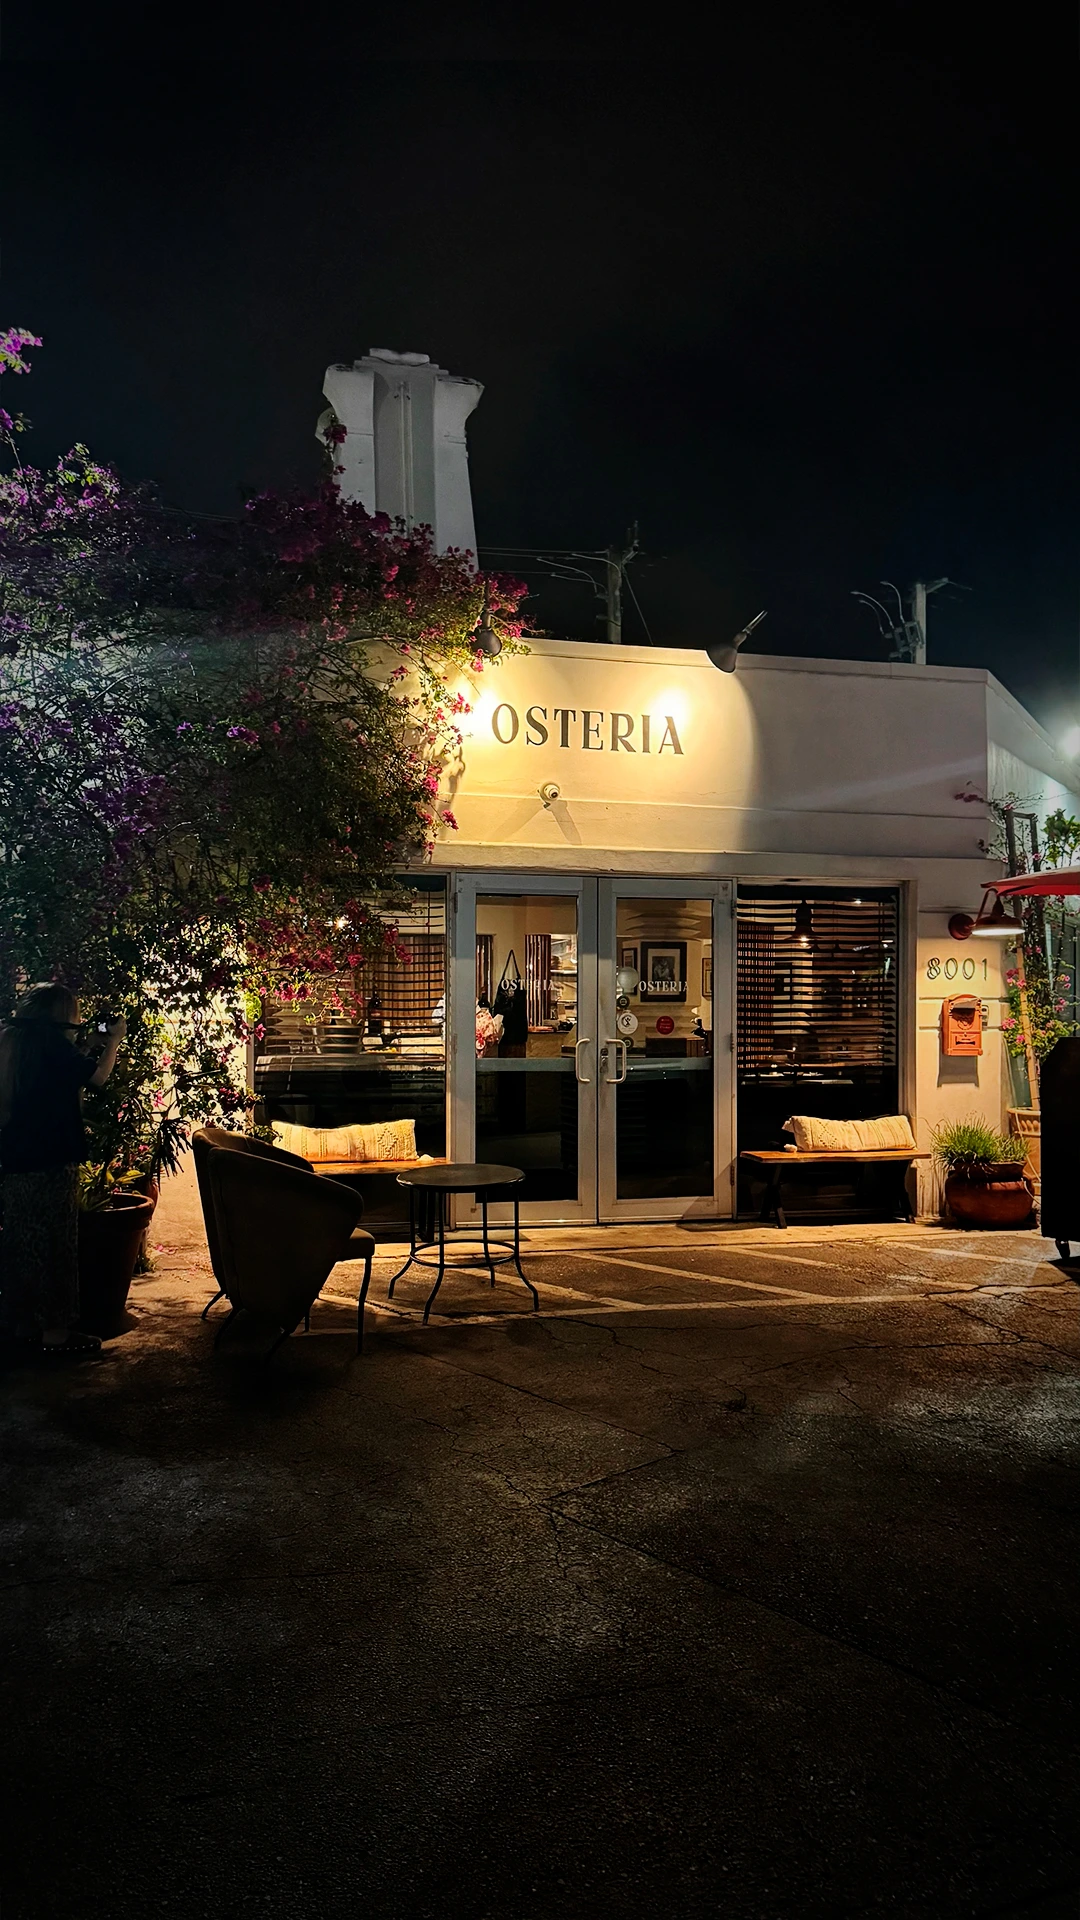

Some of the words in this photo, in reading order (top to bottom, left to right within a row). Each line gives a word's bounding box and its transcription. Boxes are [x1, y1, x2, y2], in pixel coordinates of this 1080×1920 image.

[491, 703, 685, 755] OSTERIA
[926, 957, 988, 981] 8001
[638, 980, 689, 992] OSTERIA
